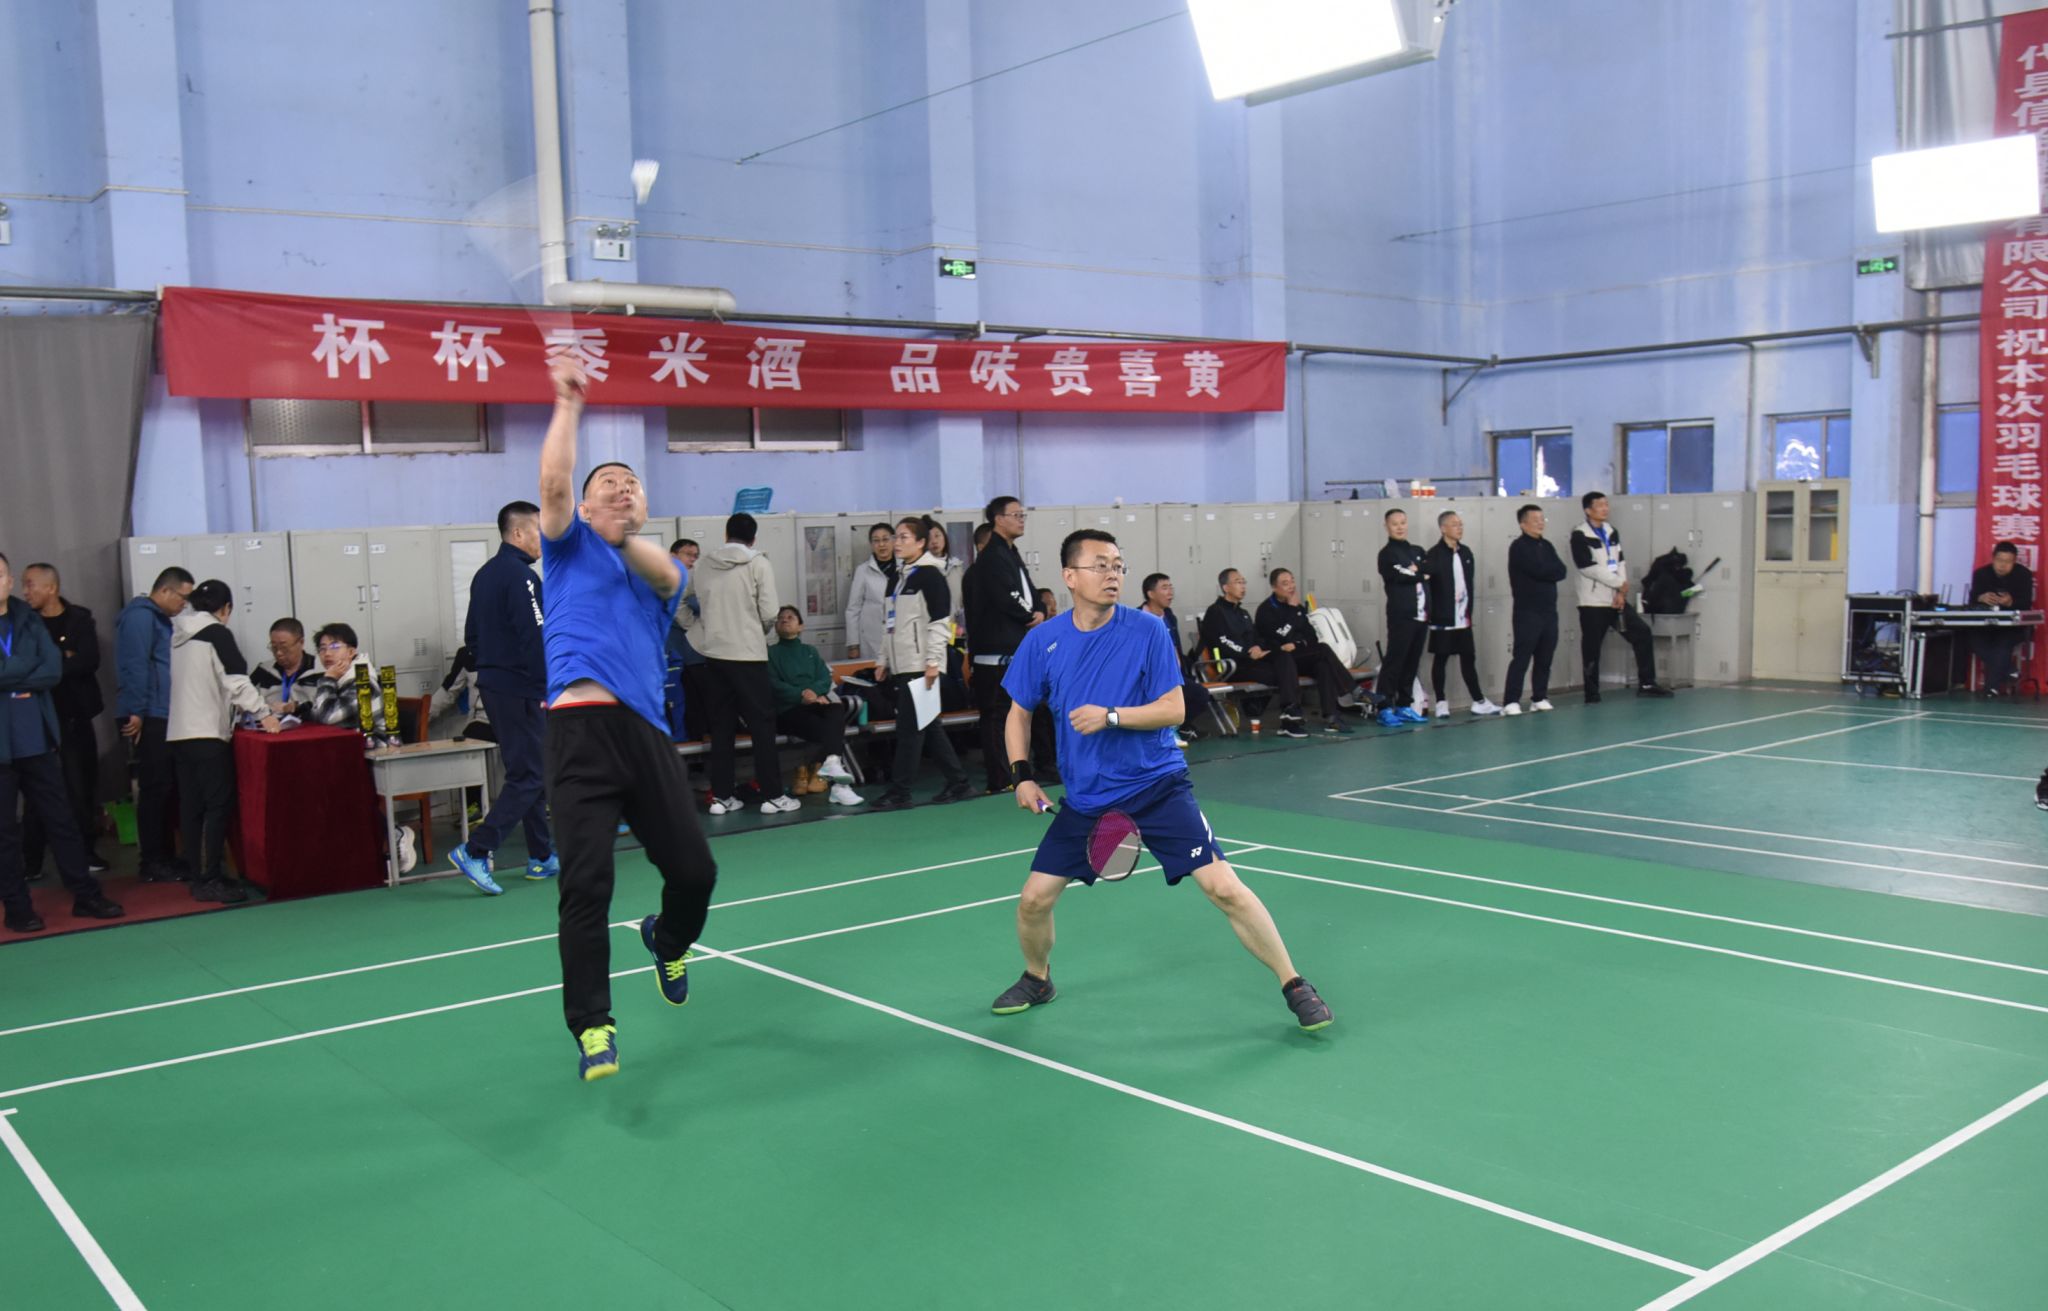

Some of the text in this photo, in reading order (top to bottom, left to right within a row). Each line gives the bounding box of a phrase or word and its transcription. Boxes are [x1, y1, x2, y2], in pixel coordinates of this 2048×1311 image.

[890, 343, 1225, 399] 品味贵喜黄
